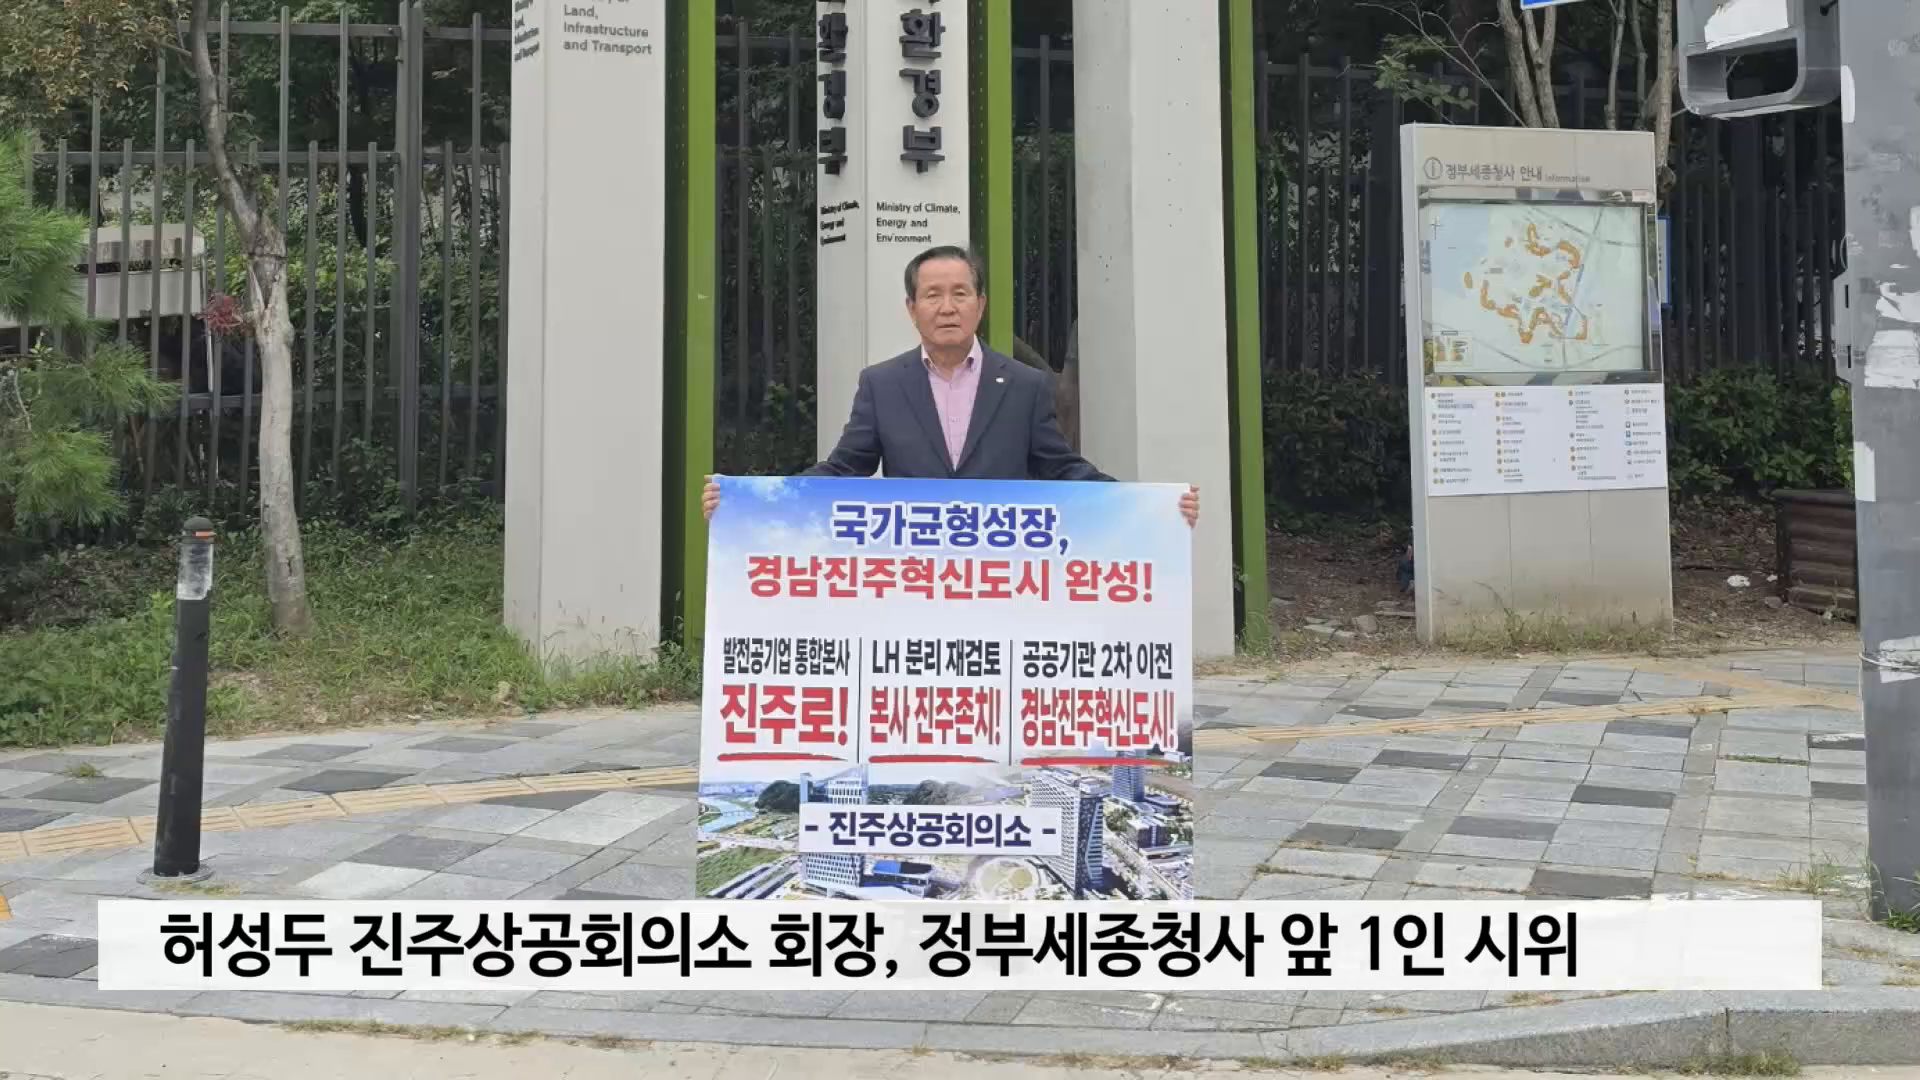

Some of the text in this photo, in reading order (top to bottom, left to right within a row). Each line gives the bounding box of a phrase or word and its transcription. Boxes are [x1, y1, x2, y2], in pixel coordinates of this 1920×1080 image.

[564, 4, 599, 19] Land,
[564, 22, 649, 37] Infrastructure
[563, 40, 652, 56] and Transport
[899, 0, 946, 173] 환경부
[1519, 165, 1543, 182] 안내
[876, 201, 961, 214] Ministry of Climate,
[876, 217, 928, 229] Energy and
[833, 504, 1068, 555] 국가균형성장,
[748, 557, 1152, 602] 경남진주혁신도시 완성!
[723, 637, 850, 676] 발전공기업 통합본사
[872, 639, 1001, 677] LH 분리 재검토
[1023, 641, 1173, 680] 공공기관 2차 이전
[720, 684, 849, 745] 진주로!
[870, 686, 1001, 745] 본사 진주존치!
[1020, 687, 1176, 748] 경남진주혁신도시!
[828, 811, 1032, 848] 진주상공회의소
